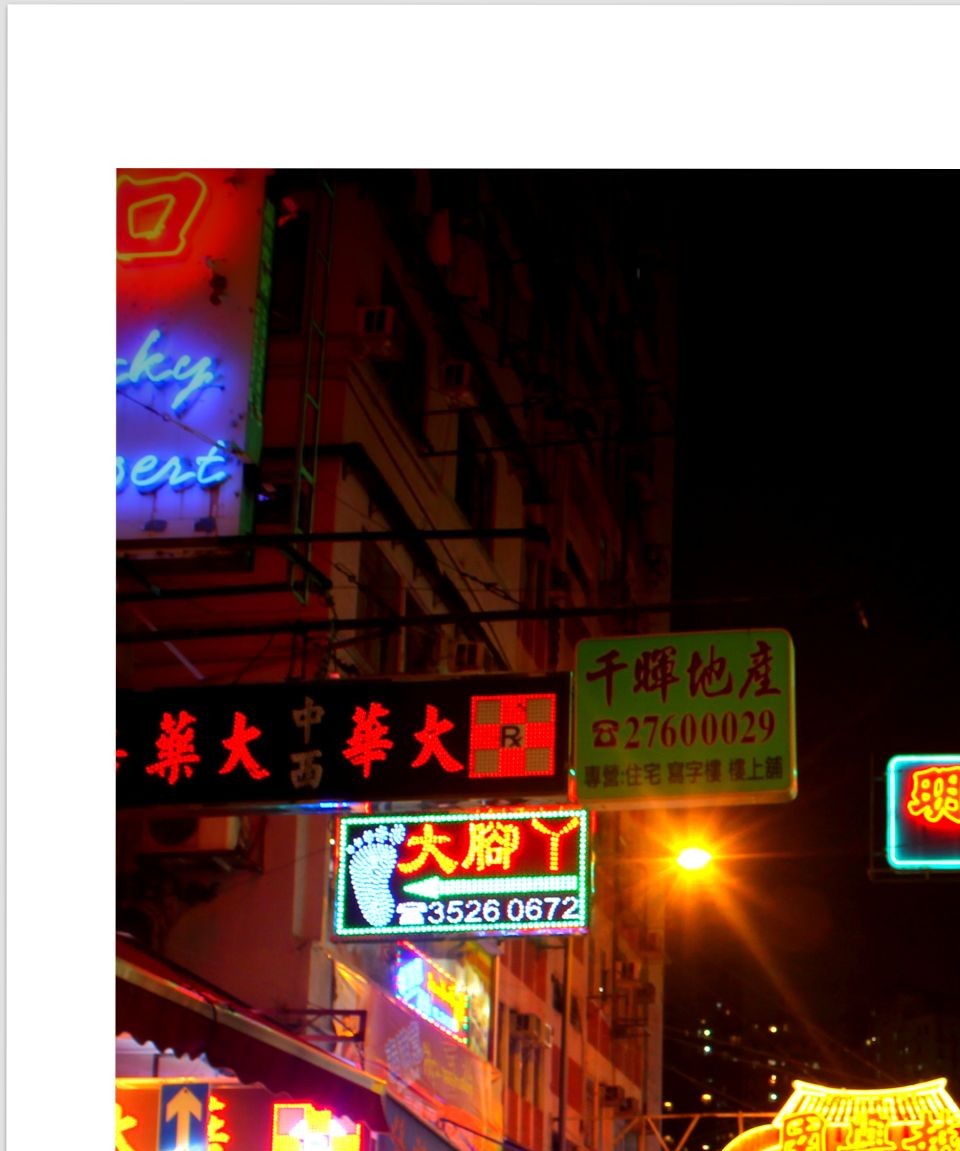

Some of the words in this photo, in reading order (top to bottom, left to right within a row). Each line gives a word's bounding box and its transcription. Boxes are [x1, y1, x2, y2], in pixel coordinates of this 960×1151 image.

[624, 710, 776, 749] 27600029
[427, 899, 501, 924] 3526
[506, 896, 579, 921] 0672
